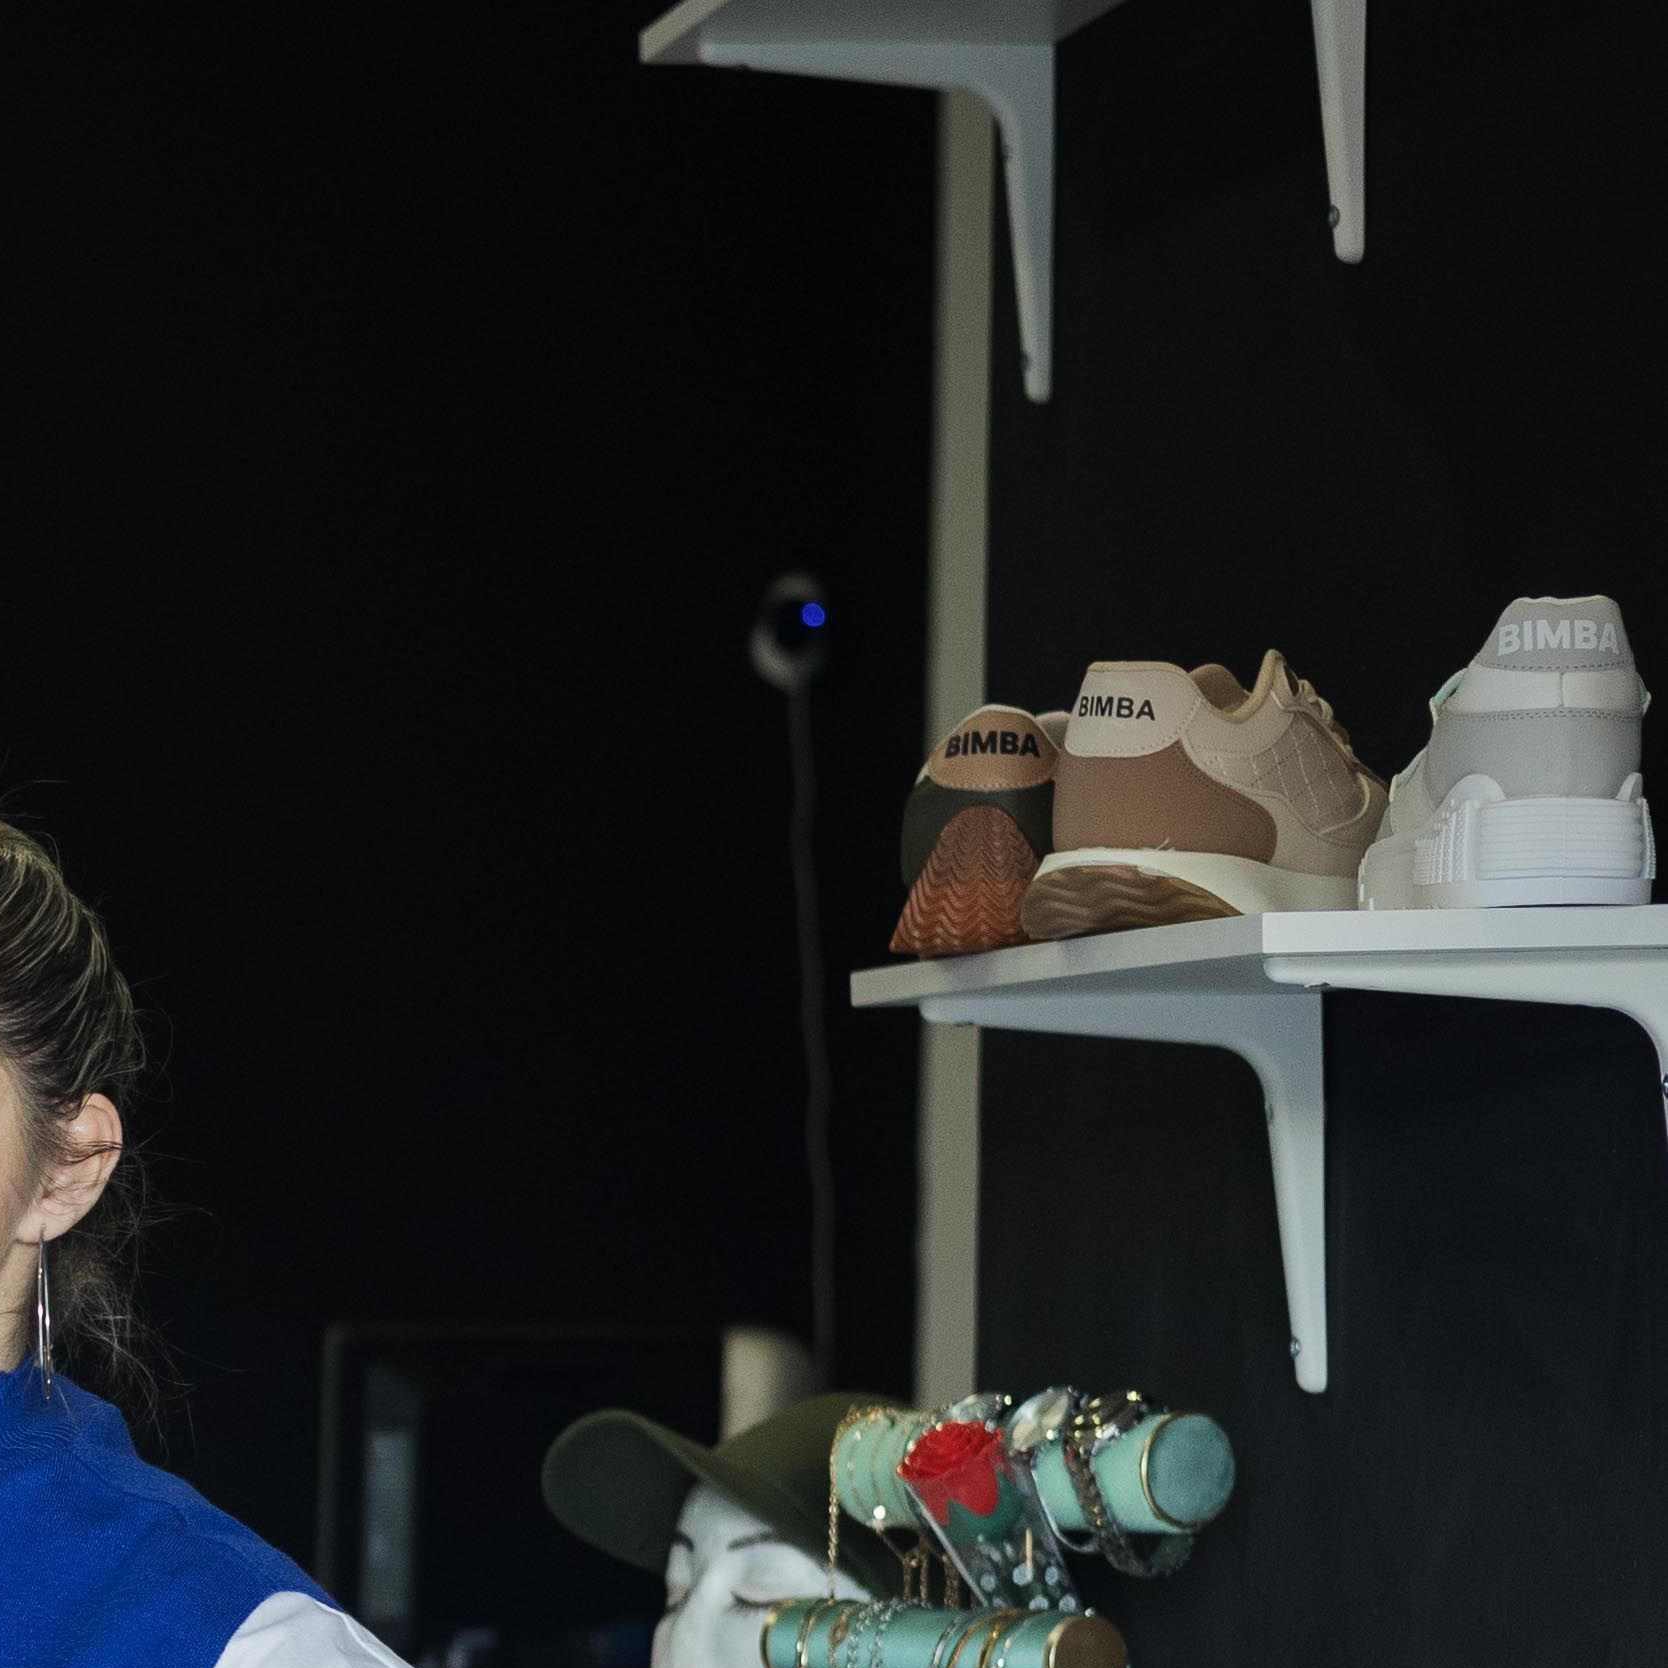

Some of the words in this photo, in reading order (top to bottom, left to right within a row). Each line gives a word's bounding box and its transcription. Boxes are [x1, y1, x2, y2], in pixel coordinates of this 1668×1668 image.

[1497, 619, 1620, 656] BIMBA
[1077, 695, 1156, 721] BIMBA
[944, 730, 1041, 758] BIMBA
